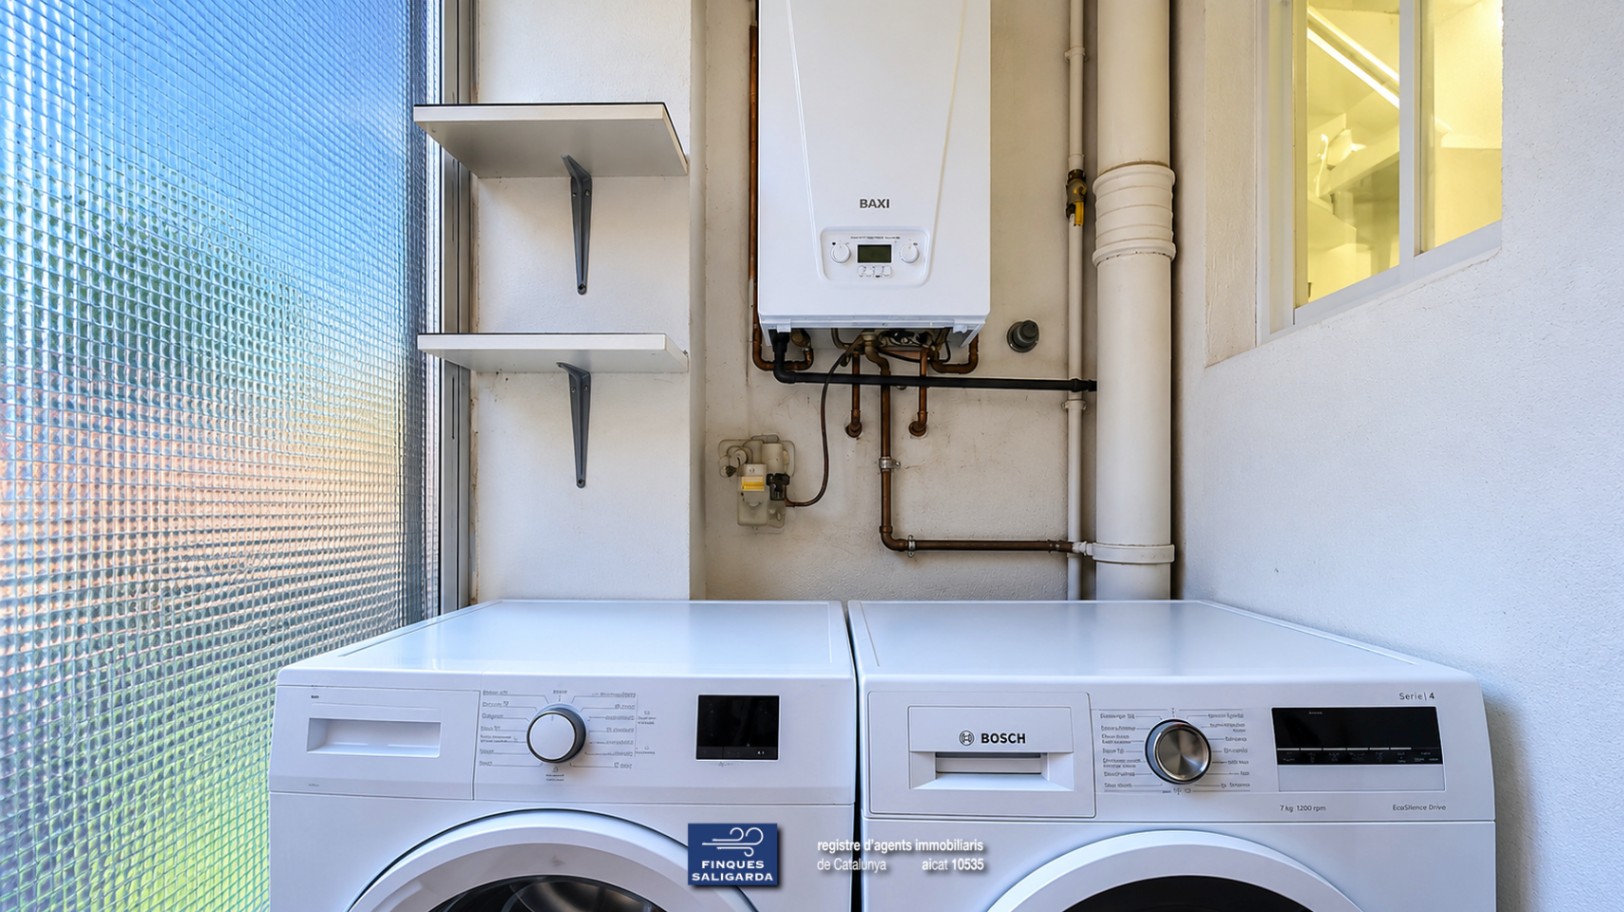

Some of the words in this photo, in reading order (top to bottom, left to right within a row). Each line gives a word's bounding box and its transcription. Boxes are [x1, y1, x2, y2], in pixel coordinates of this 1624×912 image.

[859, 198, 890, 209] BAXI
[981, 733, 1026, 744] BOSCH
[1285, 804, 1294, 813] kg
[1297, 804, 1312, 812] 1200
[1313, 805, 1327, 813] rpm
[1428, 803, 1447, 811] Drive
